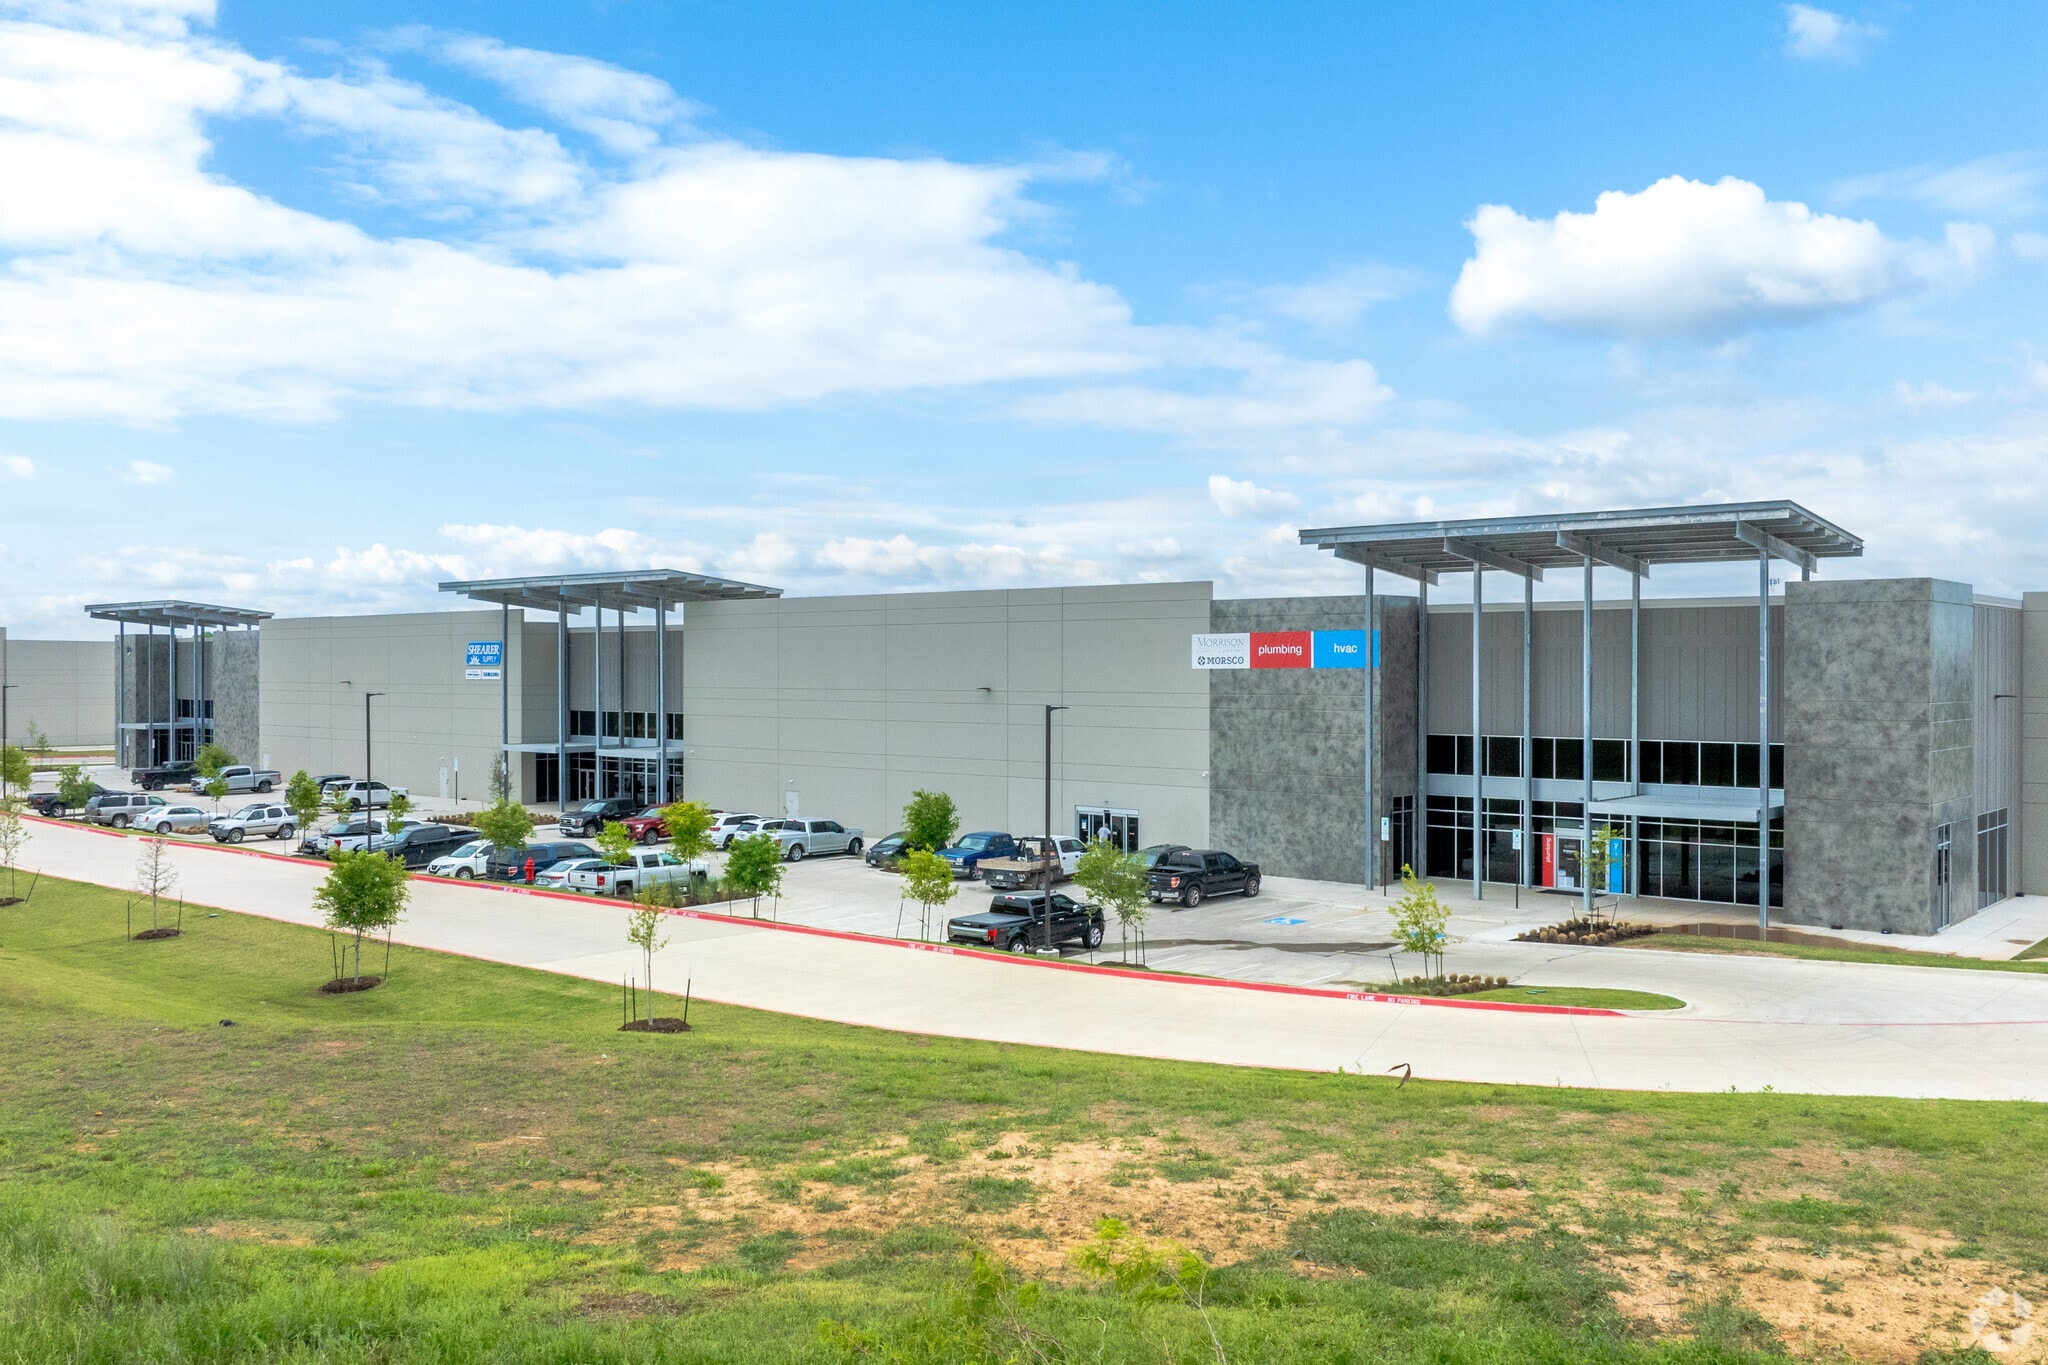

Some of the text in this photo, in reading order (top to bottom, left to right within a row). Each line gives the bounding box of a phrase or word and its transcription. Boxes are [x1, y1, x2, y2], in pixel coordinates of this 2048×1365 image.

[1197, 637, 1244, 647] MORRISON
[468, 645, 499, 654] SHEARER
[1258, 644, 1302, 656] plumbing
[1333, 643, 1358, 653] hvac
[1207, 656, 1244, 665] MORSCO
